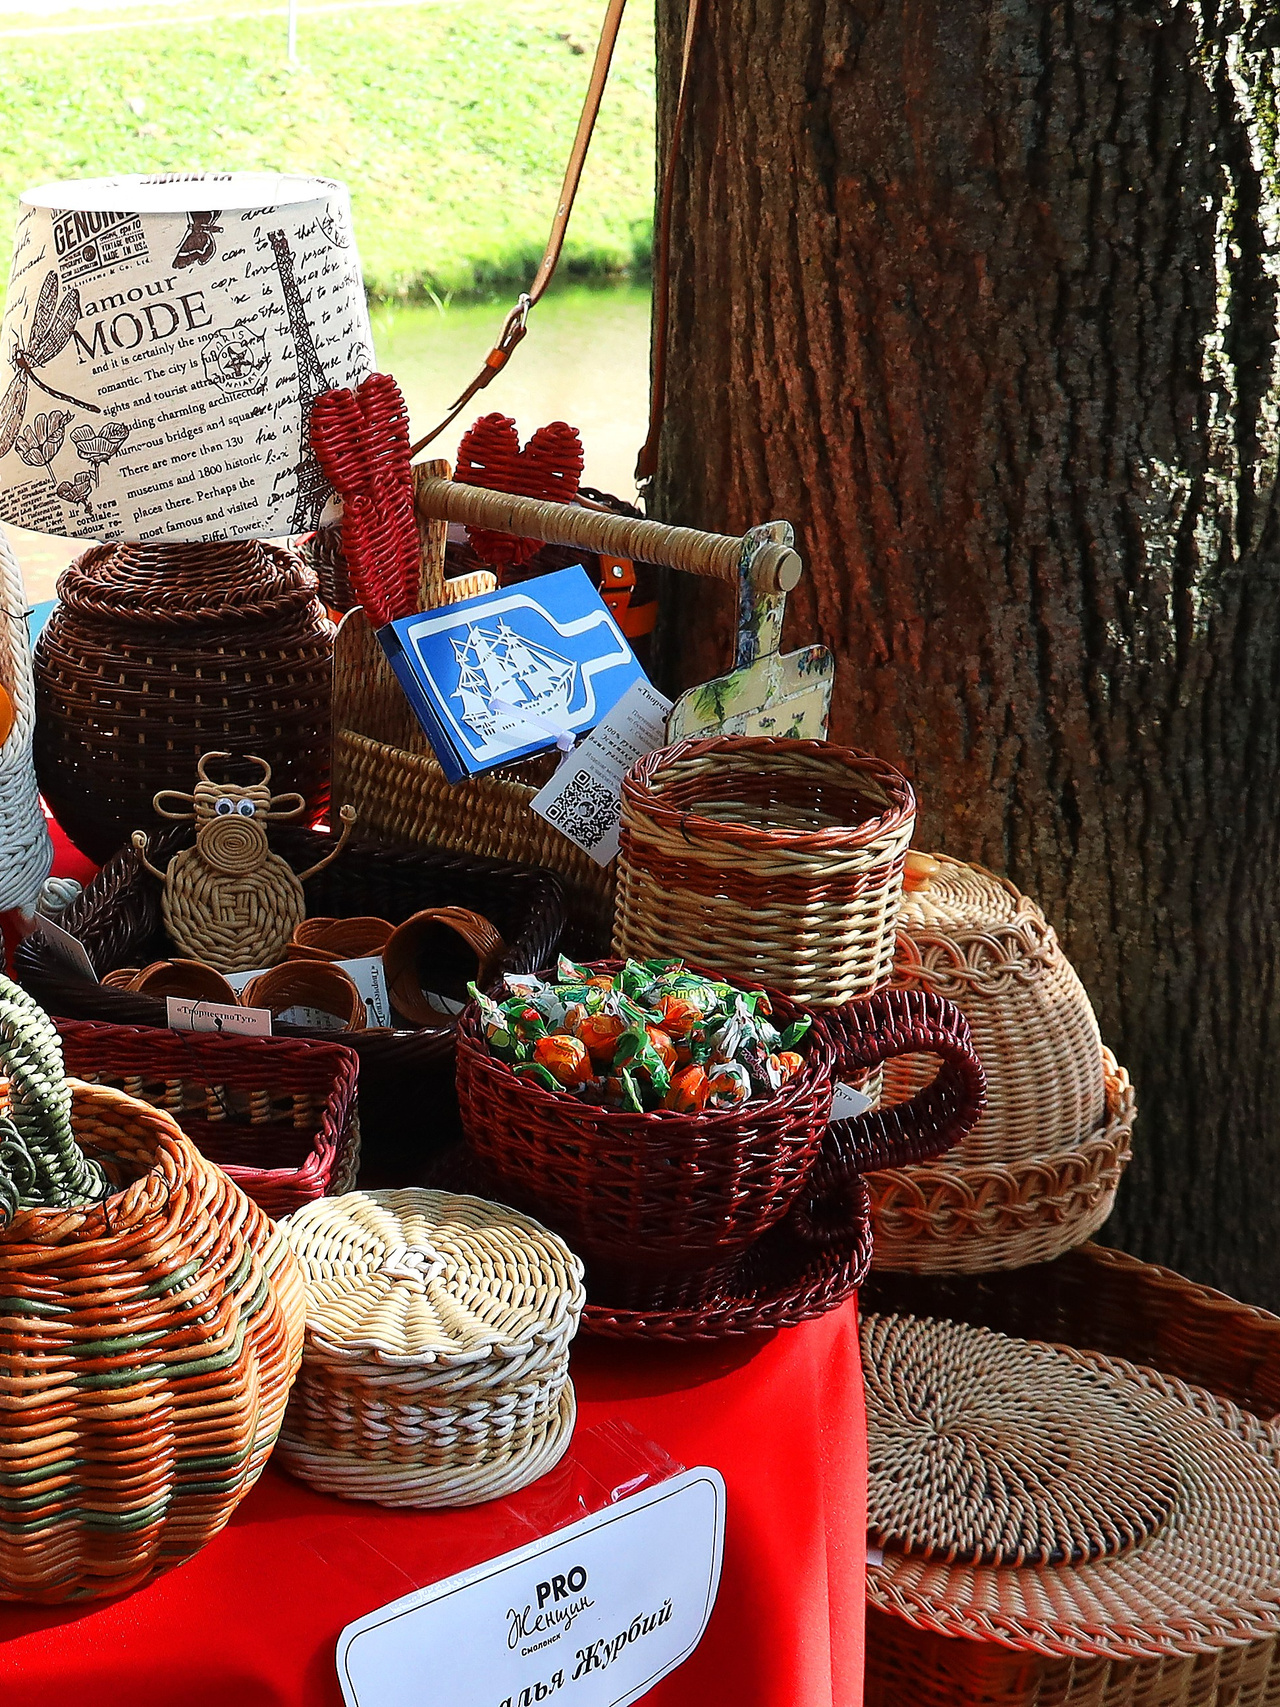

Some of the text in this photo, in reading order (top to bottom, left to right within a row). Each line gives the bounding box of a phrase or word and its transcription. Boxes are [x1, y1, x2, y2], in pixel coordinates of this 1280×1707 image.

[102, 241, 148, 262] MADE IN USA
[70, 291, 213, 364] MODE
[92, 361, 109, 375] and
[111, 357, 119, 369] it
[121, 355, 130, 366] is
[132, 345, 176, 362] certainly
[177, 338, 195, 350] the
[97, 376, 143, 396] romantic.
[144, 368, 166, 382] The
[168, 362, 187, 376] city
[189, 358, 198, 369] is
[103, 402, 130, 417] sights
[133, 394, 152, 407] and
[154, 384, 188, 400] tourist
[157, 403, 206, 423] charming
[166, 425, 203, 443] bridges
[206, 417, 225, 431] and
[120, 435, 244, 478] There are more than 130
[127, 481, 174, 499] museums
[176, 470, 196, 485] and
[198, 463, 223, 479] 1800
[225, 452, 262, 470] historic
[132, 475, 255, 523] places there. Perhaps the
[139, 525, 164, 541] most
[166, 515, 203, 532] famous
[206, 507, 225, 522] and
[227, 496, 259, 515] visited
[604, 725, 620, 739] 100%
[177, 1005, 257, 1024] «ТворчествоТут»
[536, 1566, 587, 1609] PRO
[506, 1596, 595, 1649] Женщин
[572, 1598, 673, 1681] Журбий
